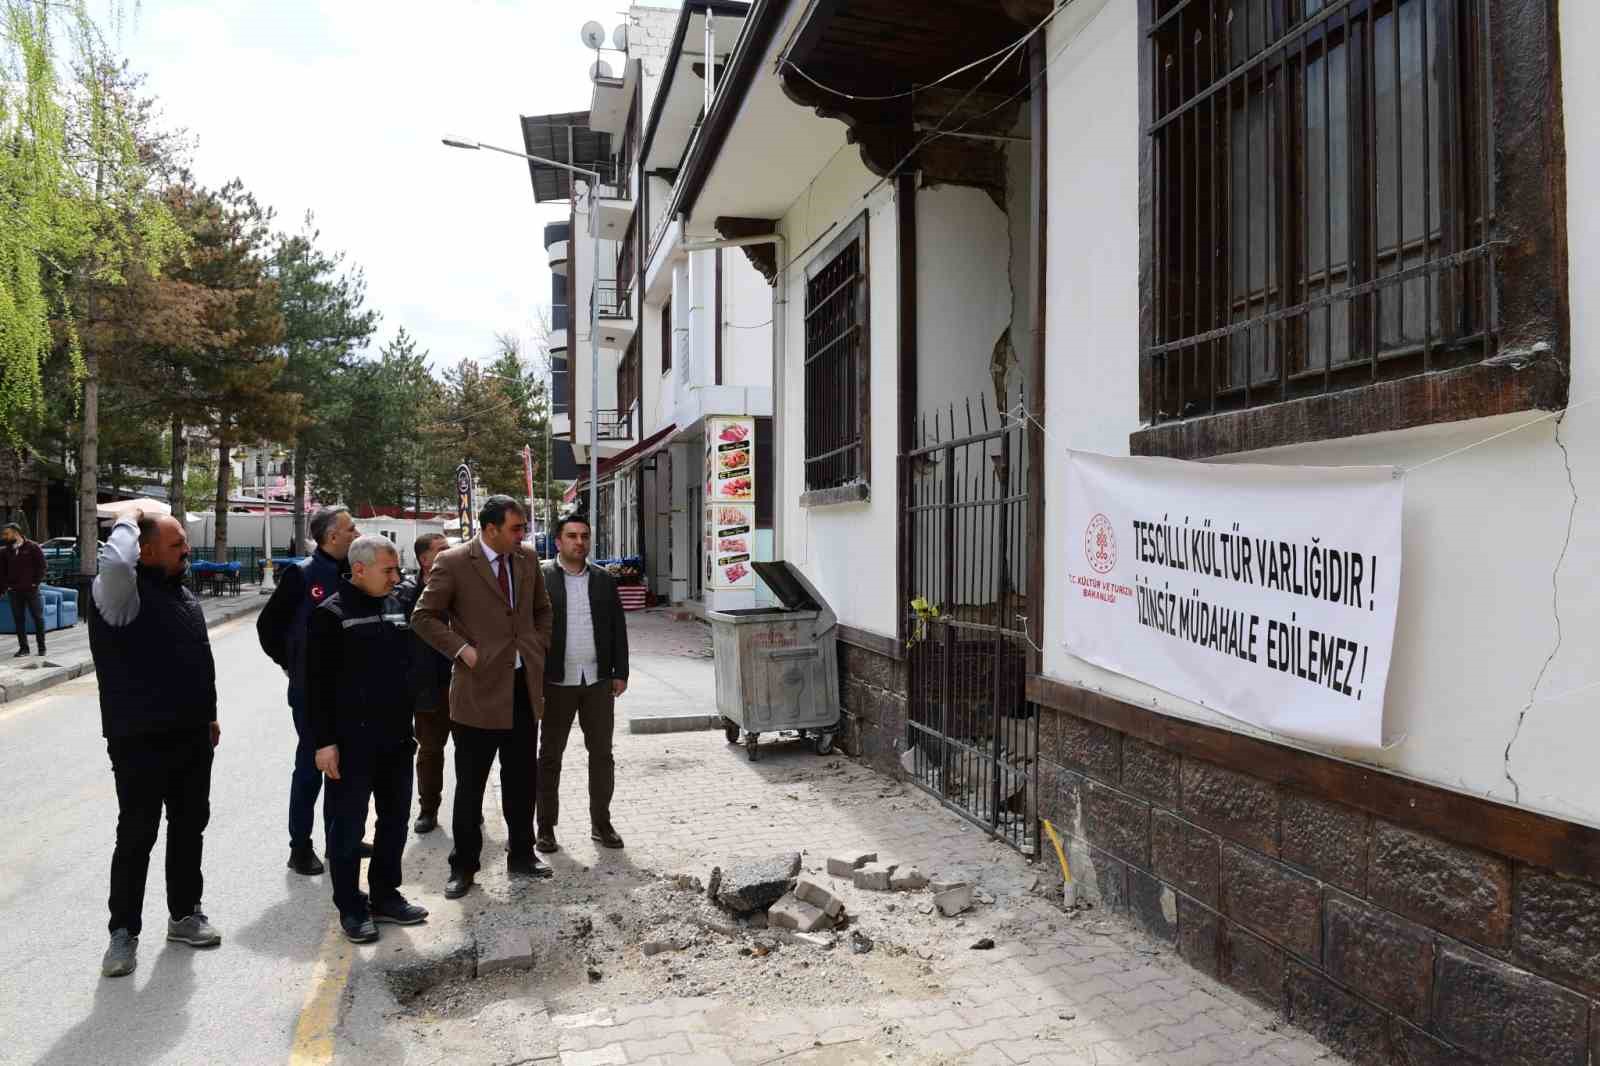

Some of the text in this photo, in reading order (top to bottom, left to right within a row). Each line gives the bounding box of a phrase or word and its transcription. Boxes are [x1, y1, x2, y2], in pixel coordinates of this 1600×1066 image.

[1132, 512, 1189, 571] TESCİLLİ
[1191, 519, 1254, 585] KÜLTÜR
[1255, 536, 1364, 608] VARLIĞIDIR
[1135, 573, 1176, 637] İZİNSİZ
[1179, 587, 1260, 664] MÜDAHALE
